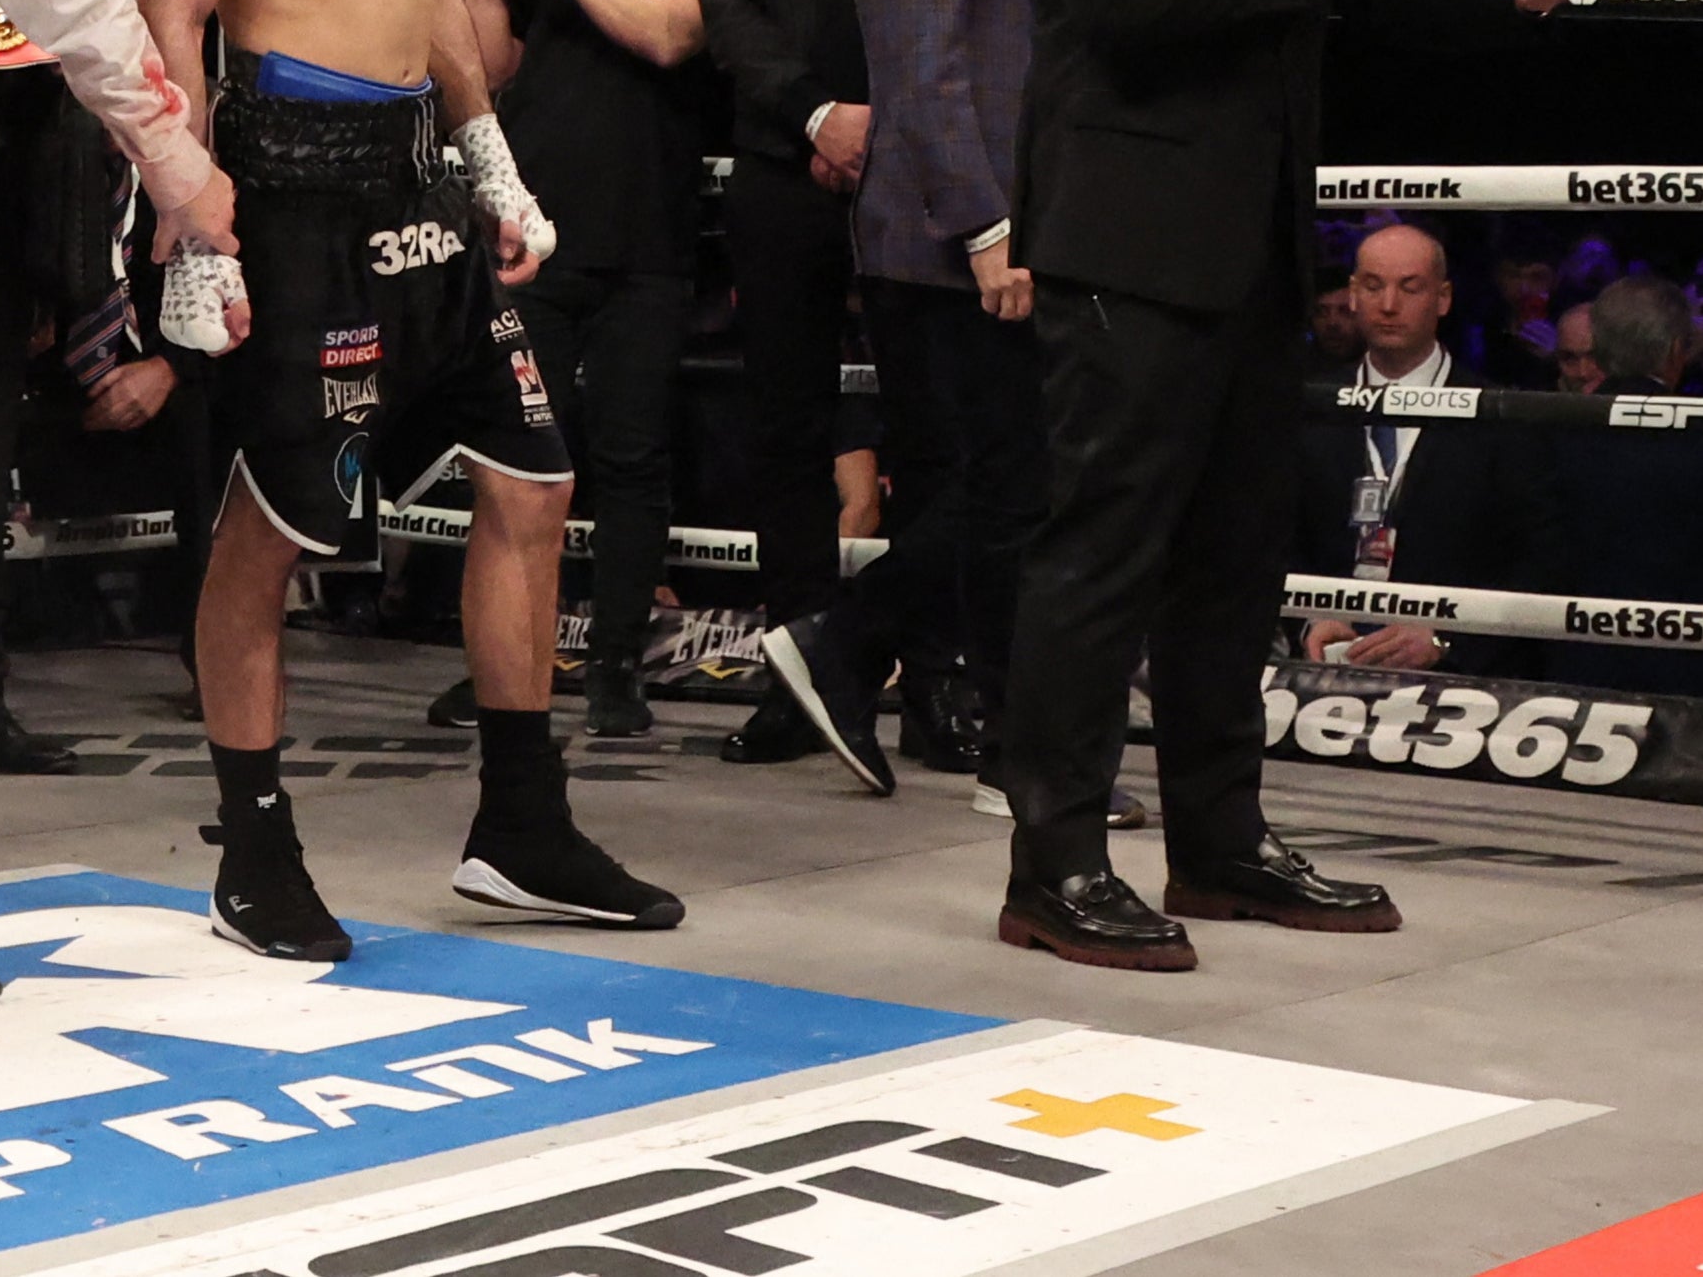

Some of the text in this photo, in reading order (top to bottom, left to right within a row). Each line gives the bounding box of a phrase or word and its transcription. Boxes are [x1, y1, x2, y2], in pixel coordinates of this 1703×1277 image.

[1373, 177, 1462, 200] Clark
[1567, 171, 1703, 204] bet365
[325, 324, 379, 346] SPORTS
[325, 343, 379, 365] DIRECT
[1336, 384, 1472, 415] sky sports
[1369, 592, 1458, 620] Clark
[1565, 601, 1703, 642] bet365
[1260, 665, 1654, 786] bet365
[102, 1017, 717, 1161] RANK
